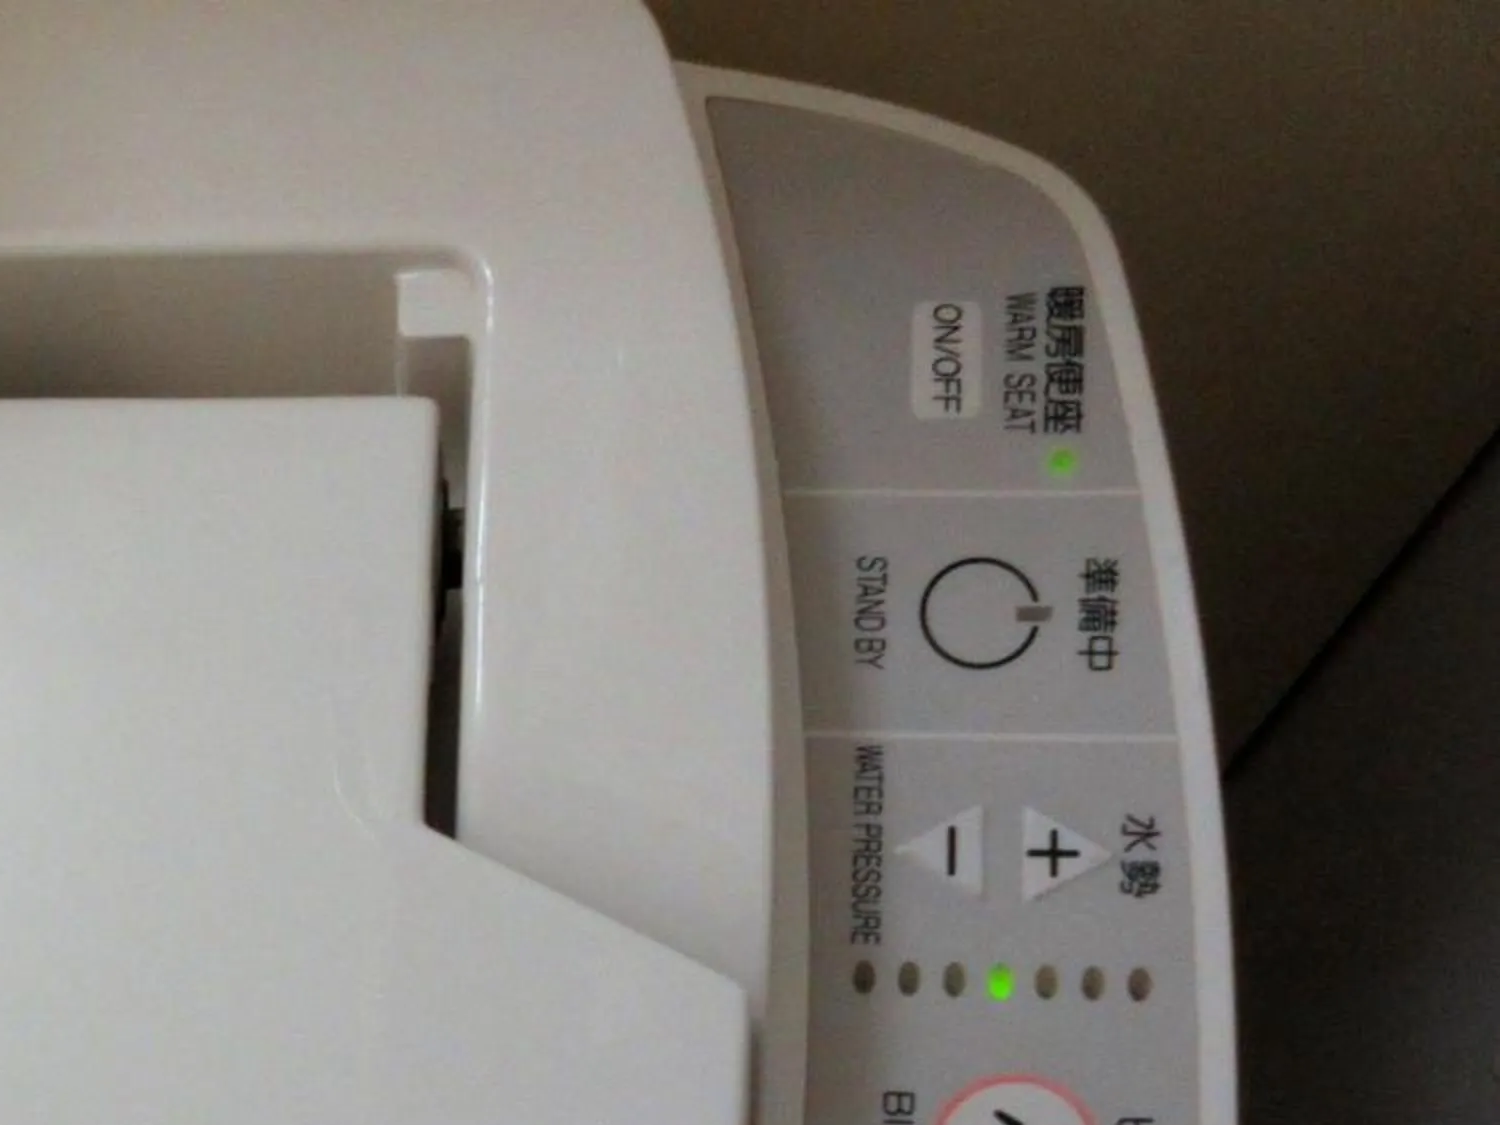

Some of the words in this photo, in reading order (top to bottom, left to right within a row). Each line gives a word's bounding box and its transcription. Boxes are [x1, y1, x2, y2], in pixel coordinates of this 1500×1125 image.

[931, 303, 964, 415] ON/OFF
[1004, 292, 1038, 362] WARM
[1043, 285, 1086, 435] 暖房便座
[1003, 374, 1037, 434] SEAT
[854, 555, 889, 635] STAND
[1077, 558, 1120, 672] 準備中
[852, 745, 884, 818] WATER
[850, 820, 883, 947] PRESSURE
[1119, 813, 1163, 899] 水勢
